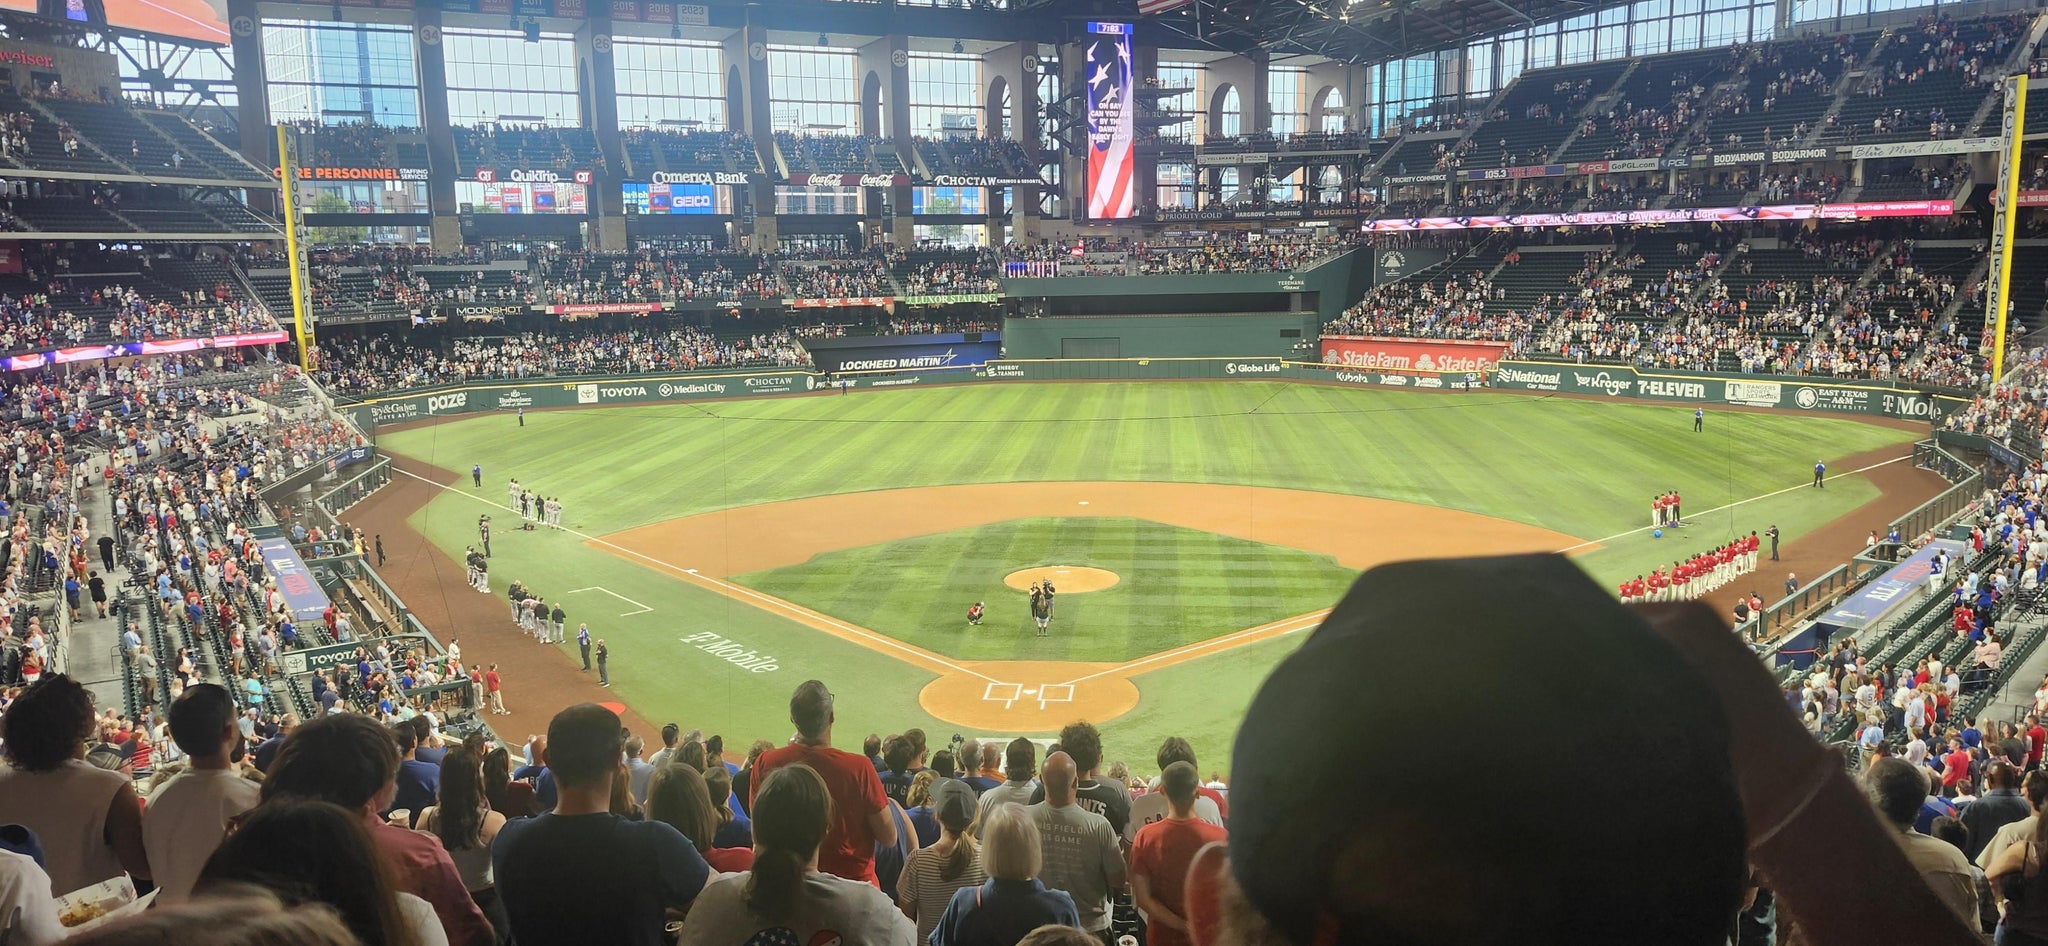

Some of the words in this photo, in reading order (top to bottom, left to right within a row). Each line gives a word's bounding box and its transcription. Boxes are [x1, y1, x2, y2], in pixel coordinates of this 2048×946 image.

[681, 5, 704, 15] 2023
[235, 20, 251, 32] 42
[423, 28, 439, 40] 34
[595, 38, 610, 49] 26
[755, 46, 761, 56] 7
[893, 52, 906, 64] 29
[1026, 59, 1035, 69] 10
[1772, 149, 1826, 159] BODYARMOR
[1854, 146, 1884, 158] Blue
[1888, 143, 1924, 155] Mint
[1667, 159, 1689, 167] PGL
[1714, 152, 1765, 163] BODYARMOR
[1998, 115, 2013, 208] CHIKIN
[1611, 162, 1656, 170] GoPGL.com
[273, 167, 312, 179] CRE
[316, 167, 400, 180] PERSONNEL
[478, 170, 493, 182] QT
[510, 169, 559, 184] QuikTrip
[576, 172, 590, 183] QT
[715, 172, 749, 184] Bank
[1391, 176, 1415, 184] PRIORITY
[1416, 174, 1447, 182] COMMERCE
[1484, 169, 1507, 179] 105.3
[941, 175, 997, 186] CHOCTAW
[1313, 208, 1358, 216] PLUCKERS
[1562, 215, 1579, 223] YOU
[1628, 212, 1662, 221] DAWN'S
[1664, 210, 1692, 220] EARLY
[1693, 209, 1719, 219] LIGHT
[298, 250, 312, 330] CHIKIN
[1989, 259, 2000, 320] FARE
[916, 295, 949, 304] LUXOR
[951, 294, 996, 303] STAFFING
[456, 306, 522, 316] MOONSHOT
[622, 304, 653, 312] Network
[840, 360, 898, 371] LOCKHEED
[900, 357, 941, 367] MARTIN
[1238, 364, 1263, 372] Globe
[1264, 363, 1280, 372] Life
[750, 377, 793, 385] CHOCTAW
[1591, 371, 1632, 396] Kroger
[600, 387, 647, 397] TOYOTA
[674, 385, 707, 394] Medical
[708, 384, 726, 393] City
[1841, 390, 1868, 398] TEXAS
[428, 393, 467, 415] paze
[1831, 397, 1853, 405] A&M
[1818, 403, 1868, 411] UNIVERSITY
[694, 639, 779, 673] Mobile
